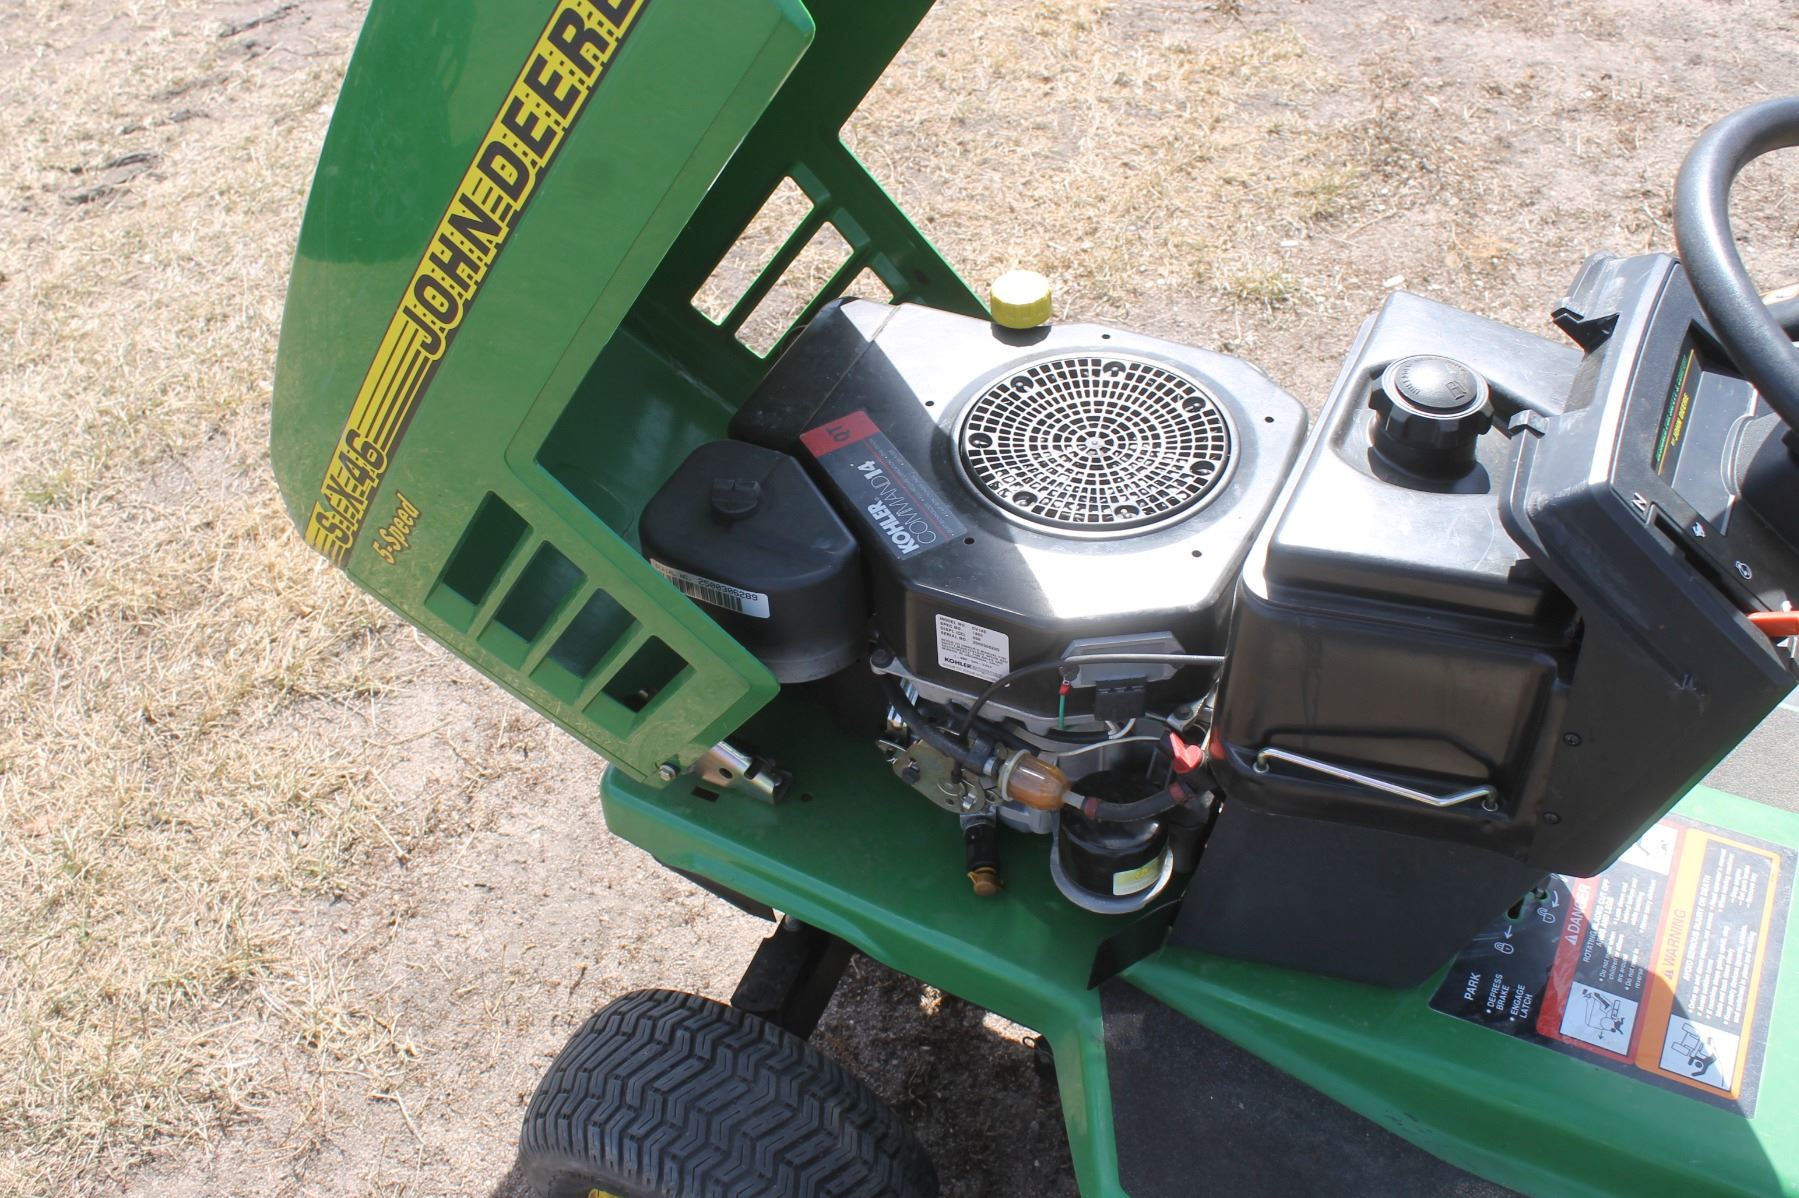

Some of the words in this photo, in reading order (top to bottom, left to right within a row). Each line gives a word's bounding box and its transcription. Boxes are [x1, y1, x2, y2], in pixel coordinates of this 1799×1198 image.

[403, 192, 501, 356] JOHN
[476, 0, 638, 206] DEER
[372, 489, 421, 565] 5-Speed
[867, 500, 920, 554] KOHLER
[944, 656, 972, 669] KOHLER
[1597, 890, 1607, 905] CUT
[1600, 877, 1610, 892] OFF
[1567, 883, 1590, 934] DANGER
[1600, 912, 1610, 928] AND
[1582, 929, 1596, 963] ROTATING
[1662, 907, 1686, 968] WARNING
[1599, 968, 1606, 977] Do
[1608, 957, 1619, 980] children
[1618, 953, 1628, 973] around
[1463, 971, 1480, 1001] PARK
[1486, 972, 1503, 1008] DEPRESS
[1625, 977, 1632, 986] Do
[1634, 967, 1643, 989] reverse
[1496, 984, 1509, 1011] BRAKE
[1510, 983, 1525, 1016] ENGAGE
[1519, 992, 1532, 1019] LATCH
